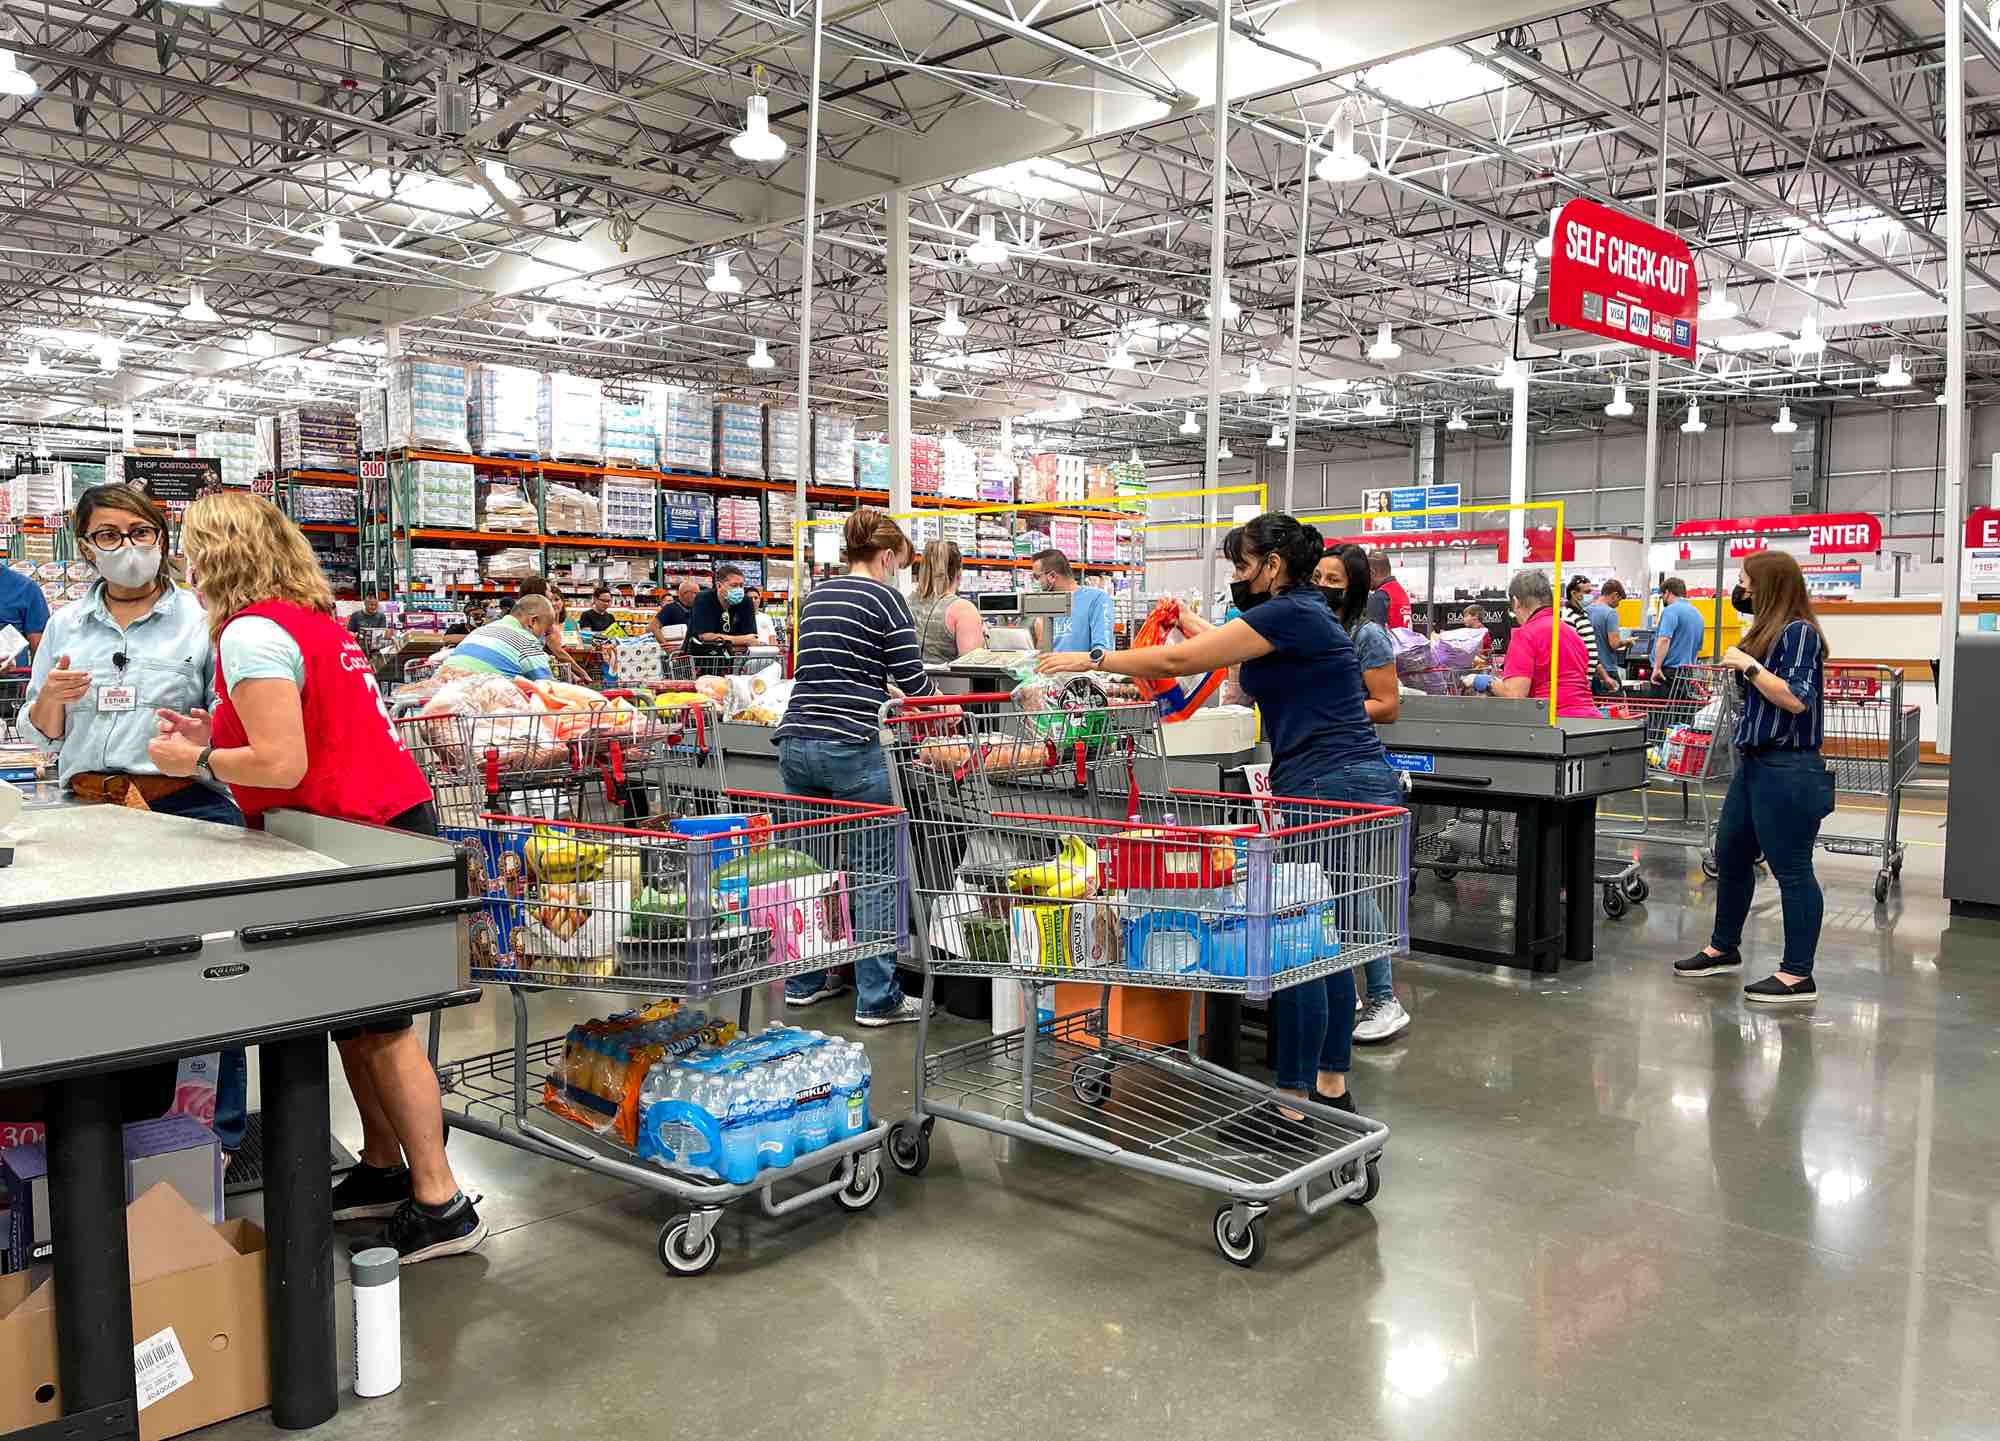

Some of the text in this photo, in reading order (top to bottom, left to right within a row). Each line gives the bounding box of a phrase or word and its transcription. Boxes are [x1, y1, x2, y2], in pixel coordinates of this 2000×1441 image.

[1566, 220, 1689, 297] SELF CHECK-OUT
[1610, 306, 1625, 321] VISA
[1631, 311, 1649, 330] ATM
[1676, 325, 1688, 338] EBT
[135, 461, 157, 470] SHOP
[362, 461, 385, 477] 300
[252, 479, 274, 494] 302
[1412, 613, 1430, 622] OLA
[1447, 612, 1464, 622] OLA
[1567, 760, 1583, 793] 11
